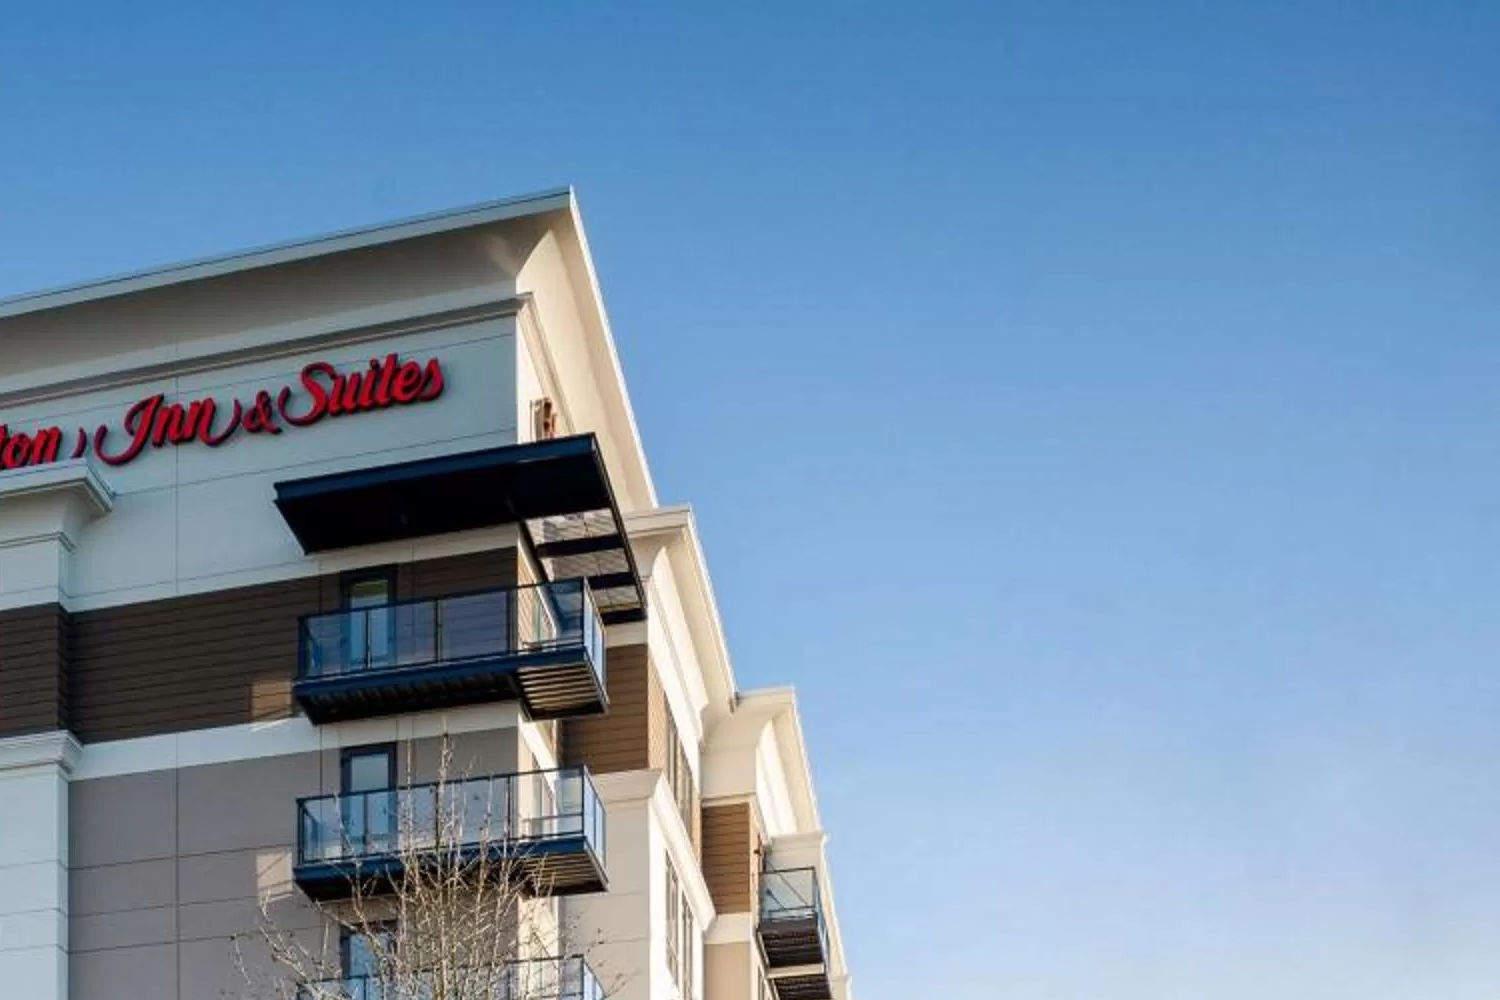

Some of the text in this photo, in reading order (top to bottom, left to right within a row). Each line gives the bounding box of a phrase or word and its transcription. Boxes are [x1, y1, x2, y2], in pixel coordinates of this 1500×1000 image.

[93, 394, 242, 466] Inn
[242, 390, 283, 434] &
[277, 353, 445, 426] Suites
